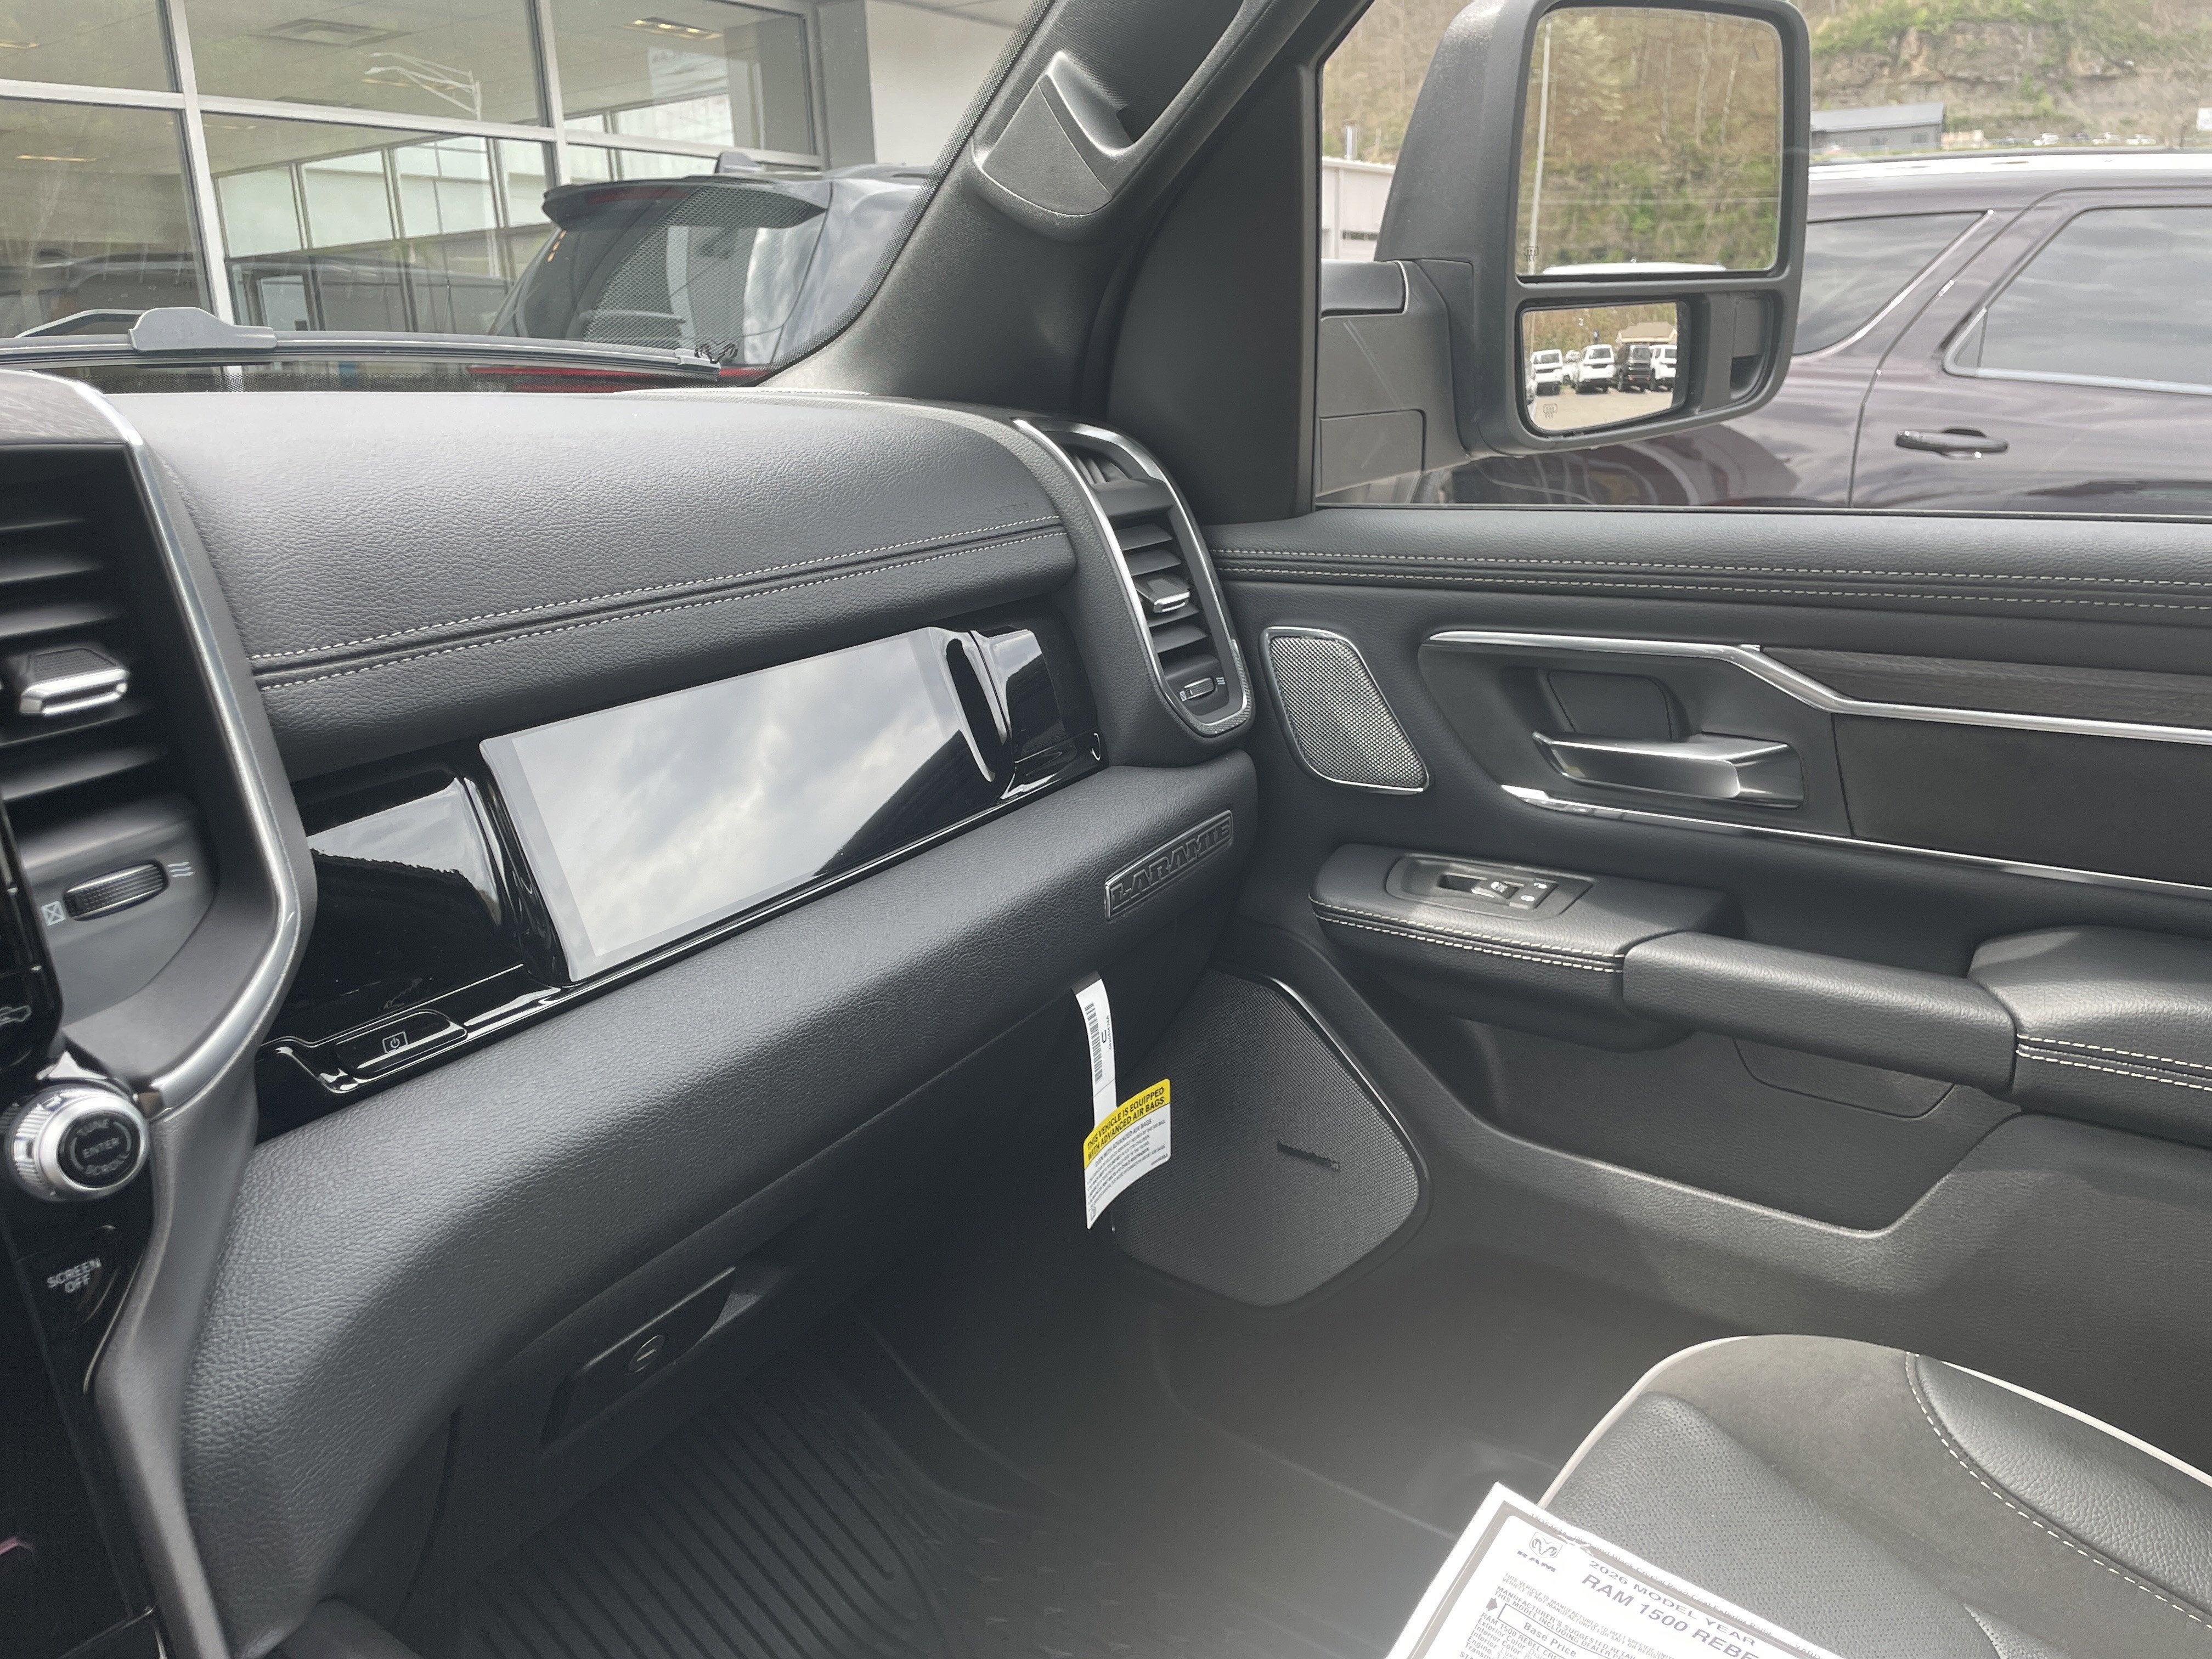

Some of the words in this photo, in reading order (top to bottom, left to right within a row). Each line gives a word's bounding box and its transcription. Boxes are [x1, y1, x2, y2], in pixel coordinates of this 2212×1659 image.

[1111, 816, 1231, 910] LARAMIE
[1088, 1133, 1098, 1150] THIS
[1099, 1112, 1121, 1137] VEHICLE
[1122, 1107, 1128, 1118] IS
[1130, 1087, 1164, 1112] EQUIPPED
[1088, 1142, 1100, 1161] WITH
[1101, 1115, 1131, 1147] ADVANCED
[1133, 1107, 1144, 1121] AIR
[1145, 1096, 1164, 1113] BAGS
[1113, 1131, 1133, 1149] ADVANCED
[1140, 1118, 1152, 1130] BAGS
[82, 1137, 120, 1158] ENTER
[47, 1257, 101, 1288] SCREEN
[64, 1273, 91, 1293] OFF
[1517, 1550, 1555, 1572] RAM
[1496, 1586, 1562, 1627] MANUFACTURER'S
[1564, 1622, 1608, 1651] SUGGESTED
[1502, 1577, 1526, 1593] VEHICLE
[1533, 1595, 1545, 1604] NOT
[1547, 1602, 1595, 1631] MANUFACTURED
[1596, 1628, 1609, 1638] FOR
[1504, 1573, 1517, 1583] THIS
[1518, 1581, 1542, 1596] VEHICLE
[1550, 1599, 1599, 1628] MANUFACTURED
[1582, 1573, 1635, 1606] RAM
[1640, 1604, 1688, 1632] 1500
[1589, 1561, 1628, 1585] 2026
[1633, 1583, 1697, 1620] MODEL
[1706, 1618, 1755, 1646] YEAR
[1474, 1624, 1500, 1643] Interior
[1477, 1618, 1505, 1637] Exterior
[1481, 1612, 1498, 1625] RAM
[1499, 1623, 1517, 1637] 1500
[1517, 1634, 1542, 1651] REBEL
[1494, 1591, 1510, 1602] THIS
[1511, 1601, 1538, 1618] MODEL
[1538, 1617, 1579, 1643] INCLUDING
[1581, 1638, 1610, 1659] DEALER
[1523, 1622, 1548, 1641] Base
[1550, 1638, 1577, 1658] Price
